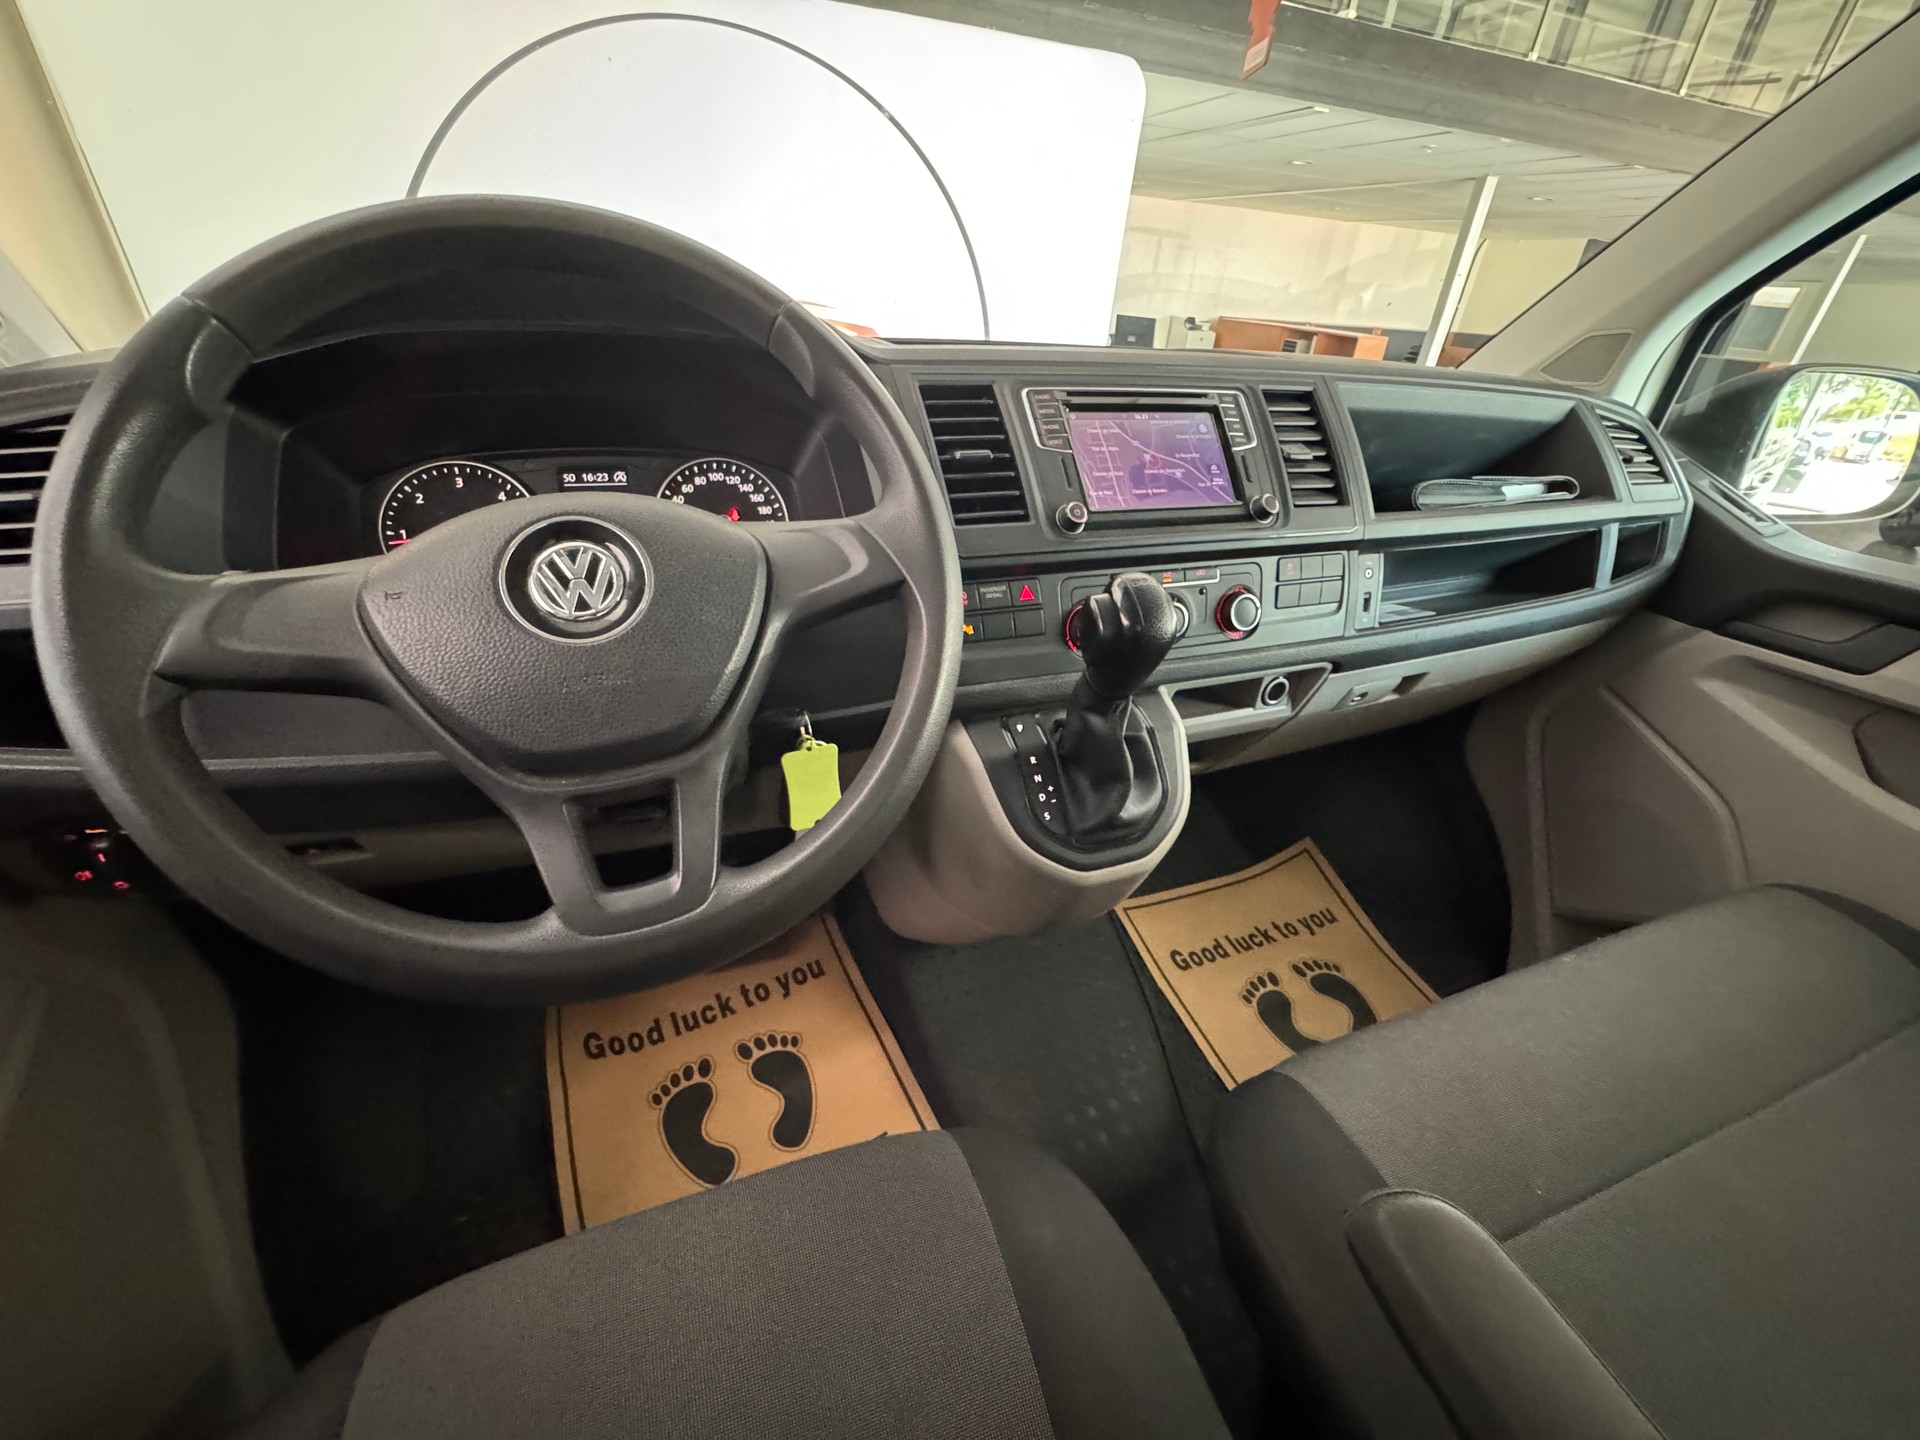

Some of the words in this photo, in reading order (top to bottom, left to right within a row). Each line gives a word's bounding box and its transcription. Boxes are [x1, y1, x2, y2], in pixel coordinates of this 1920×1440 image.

[582, 472, 609, 482] 16:23
[694, 476, 707, 485] 80
[707, 472, 725, 482] 100
[724, 475, 741, 484] 120
[455, 477, 464, 488] 3
[738, 483, 754, 492] 140
[681, 484, 694, 493] 60
[415, 493, 424, 504] 2
[497, 491, 507, 501] 4
[671, 495, 685, 504] 40
[749, 493, 765, 502] 160
[757, 505, 773, 515] 180
[399, 529, 407, 540] 1
[531, 542, 623, 618] VW
[1029, 756, 1037, 765] R
[1034, 774, 1043, 783] N
[1038, 793, 1047, 802] D
[1043, 811, 1051, 821] S
[1170, 938, 1231, 972] Good
[1224, 925, 1278, 954] luck
[1271, 921, 1300, 939] to
[1297, 907, 1339, 937] you
[583, 1017, 666, 1060] Good
[670, 992, 738, 1038] luck
[739, 983, 772, 1008] to
[775, 958, 826, 999] you
